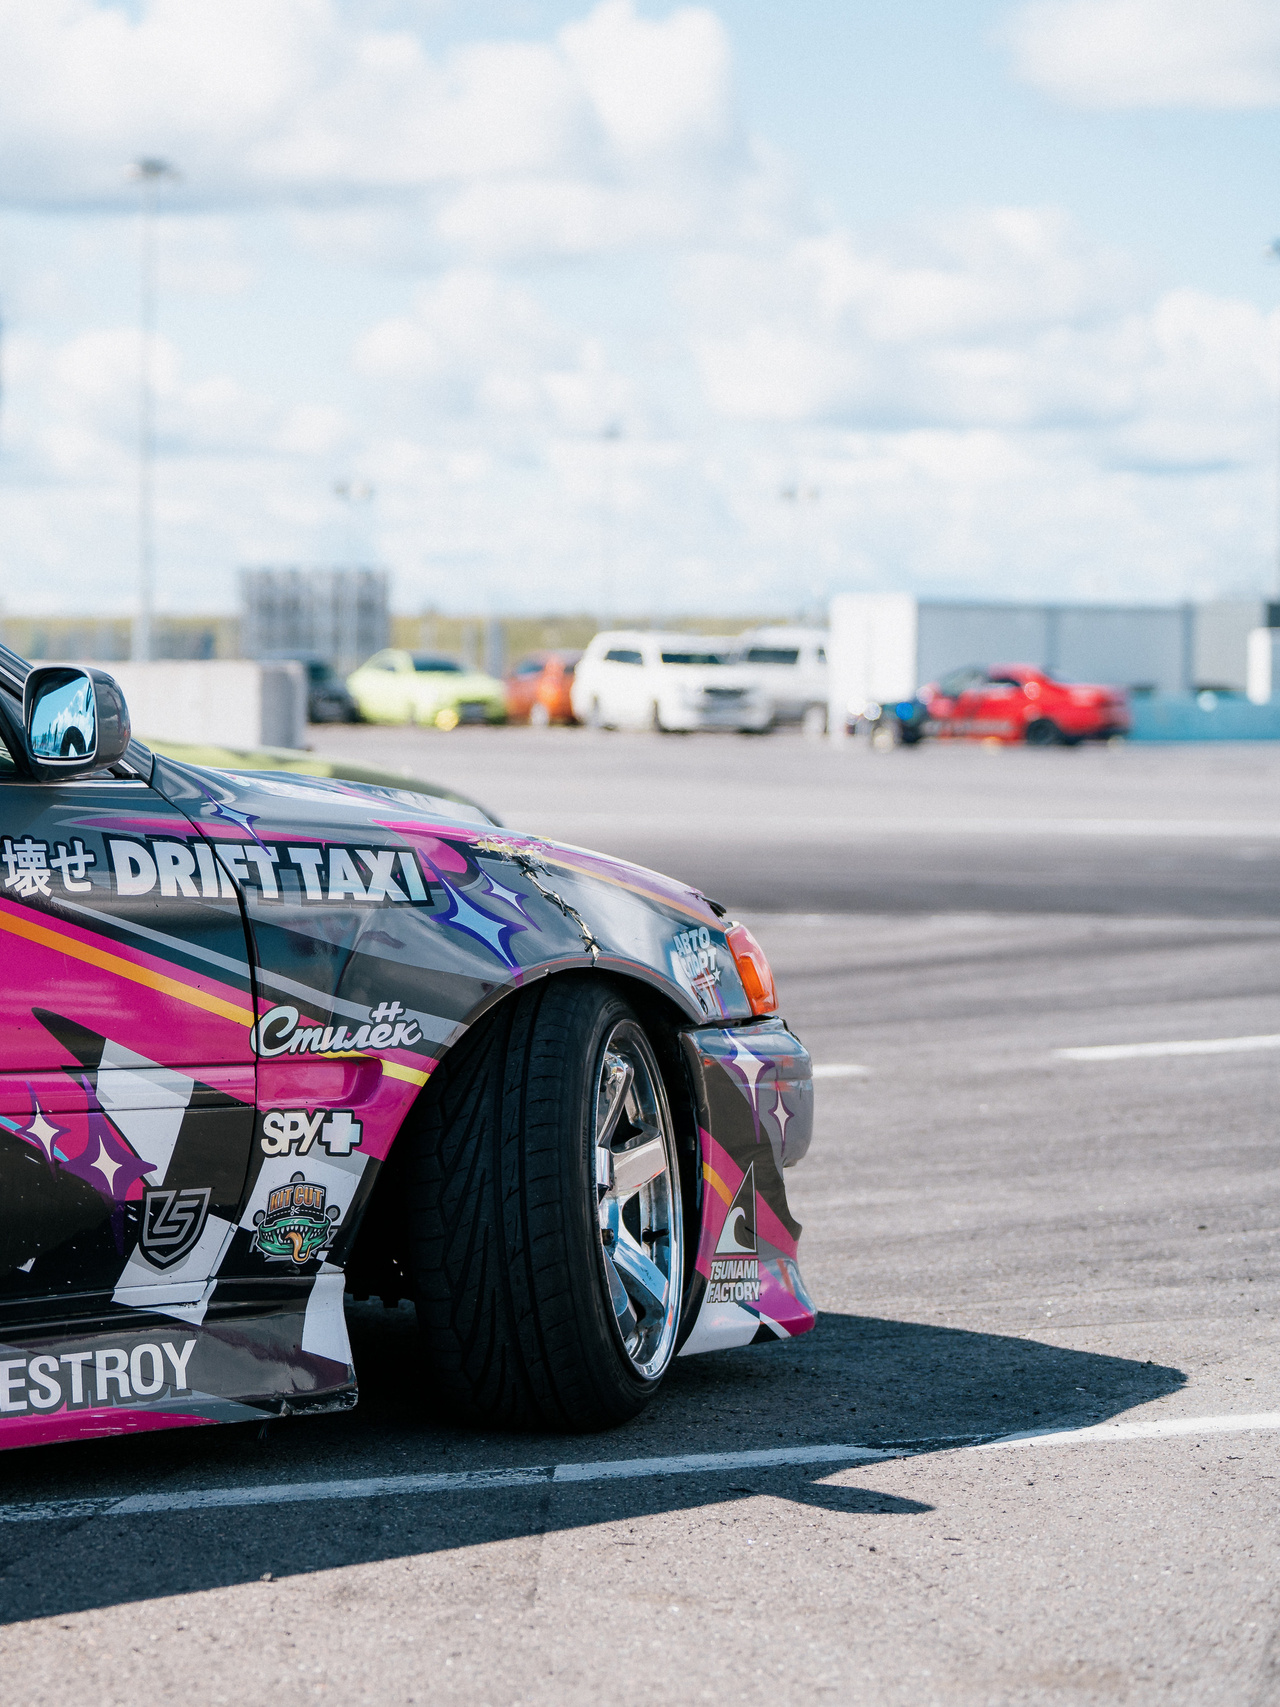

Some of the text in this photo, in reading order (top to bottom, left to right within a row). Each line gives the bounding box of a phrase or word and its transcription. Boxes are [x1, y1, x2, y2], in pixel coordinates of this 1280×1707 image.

[109, 840, 428, 901] DRIFT TAXI
[269, 1185, 325, 1212] KIT CUT
[710, 1259, 759, 1280] TSUNAMI
[707, 1281, 760, 1302] FACTORY
